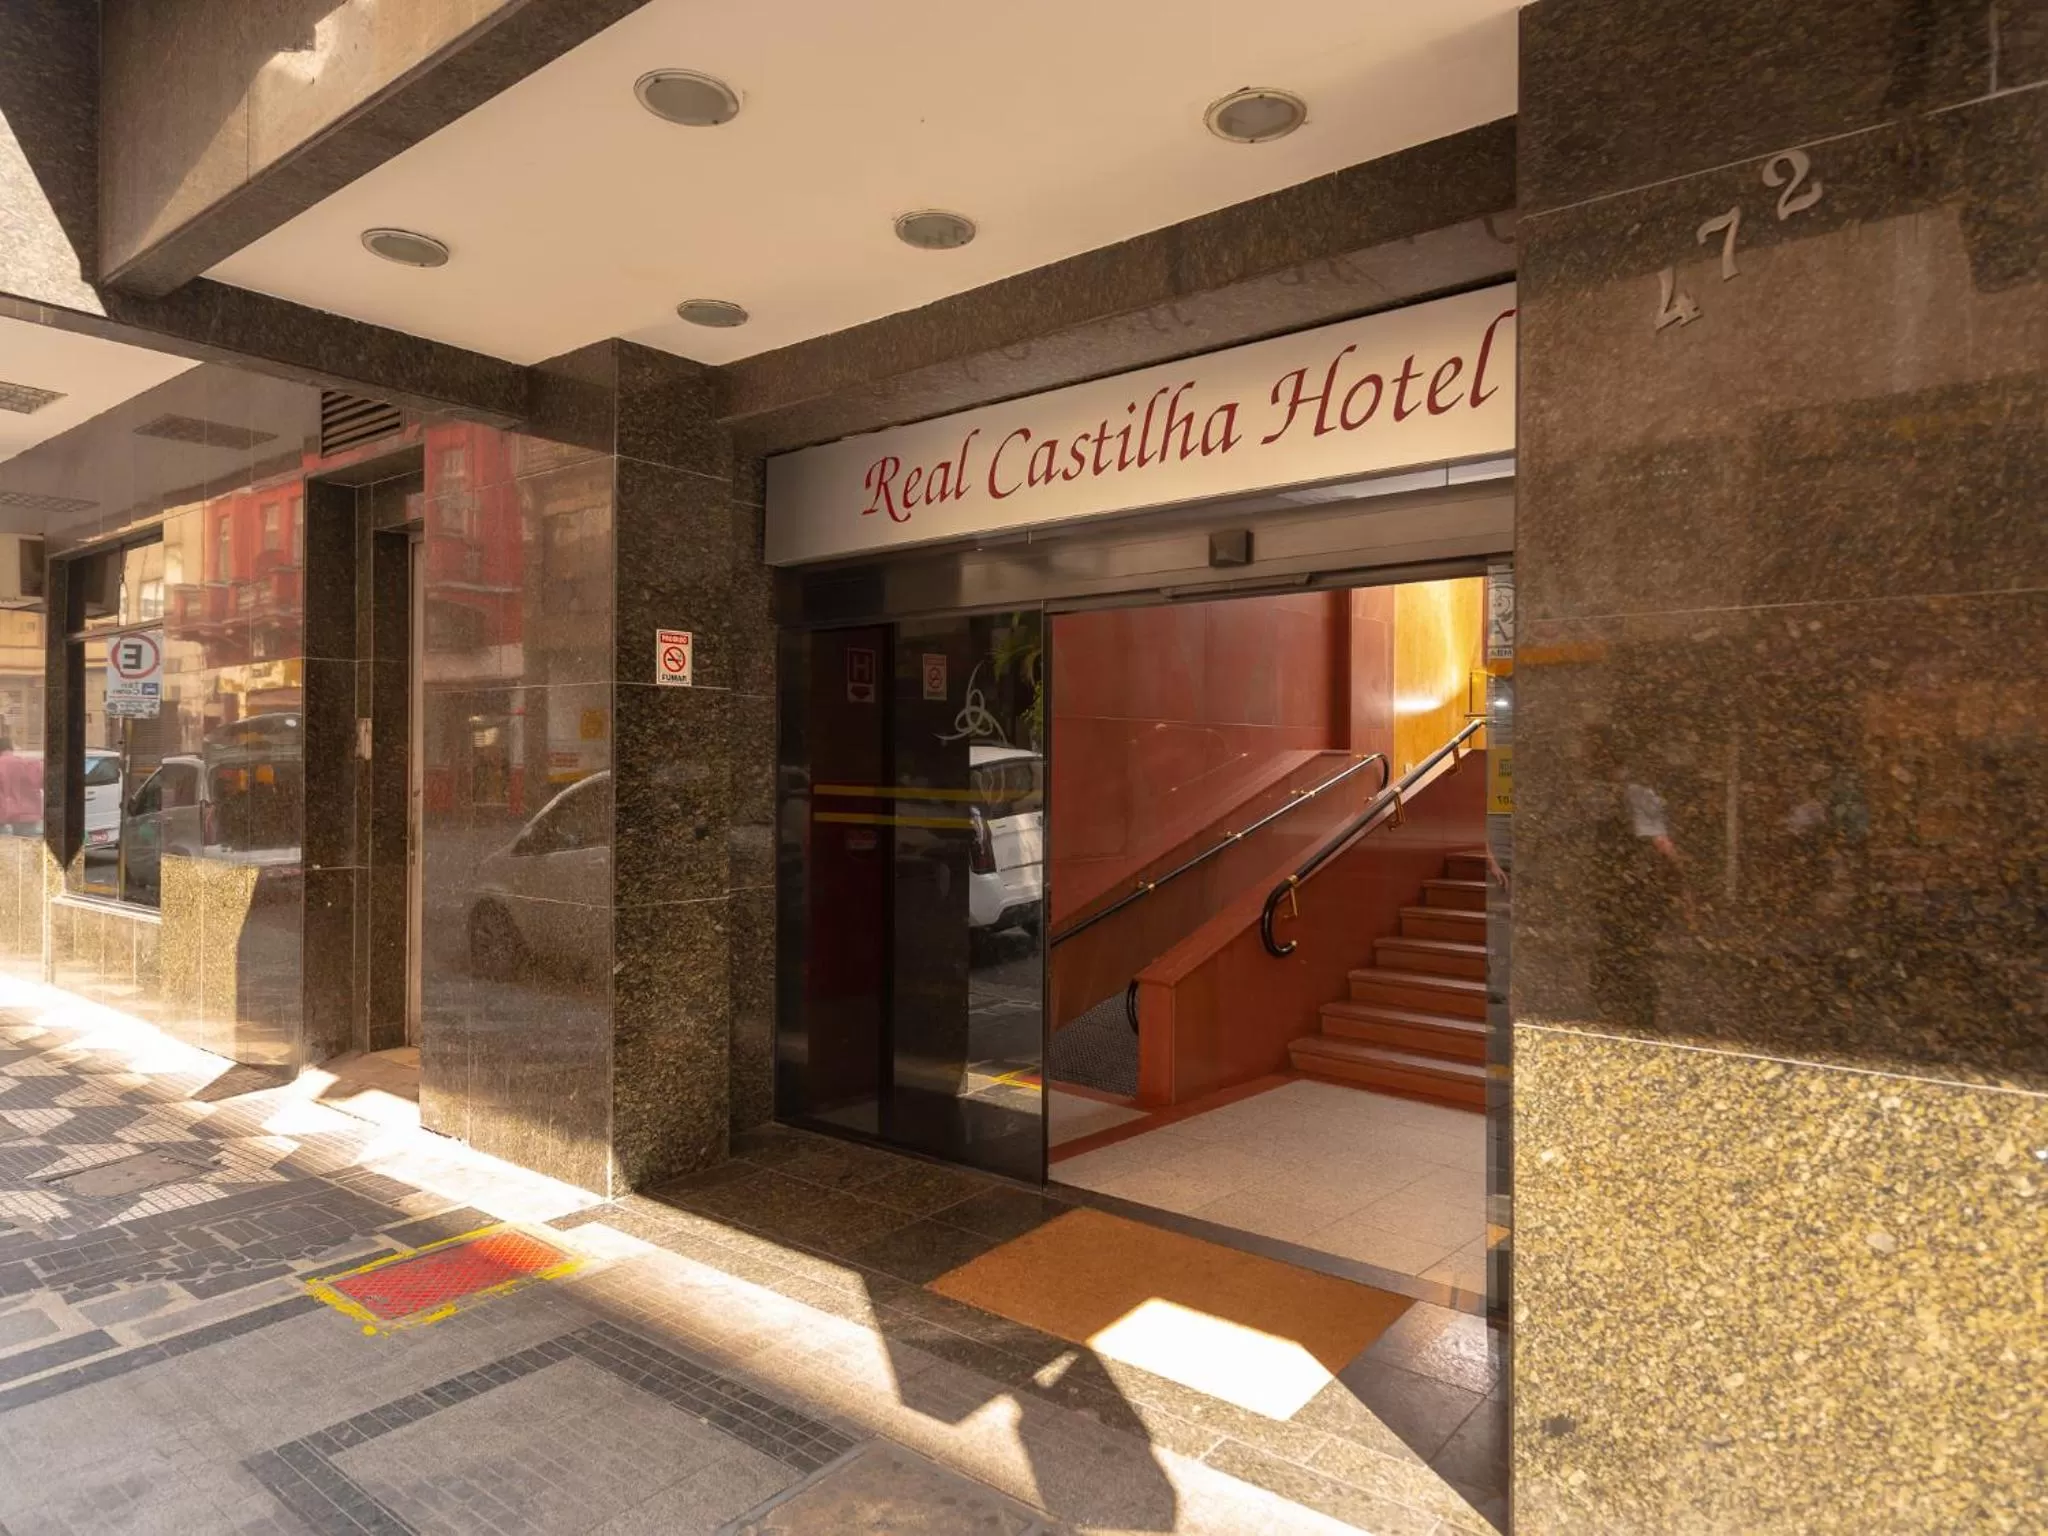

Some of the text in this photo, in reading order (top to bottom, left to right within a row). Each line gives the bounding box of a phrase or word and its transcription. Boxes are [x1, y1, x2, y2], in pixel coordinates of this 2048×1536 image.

[1655, 150, 1823, 334] 472
[862, 309, 1516, 523] Real Castilha Hotel
[661, 673, 687, 682] FUMAR
